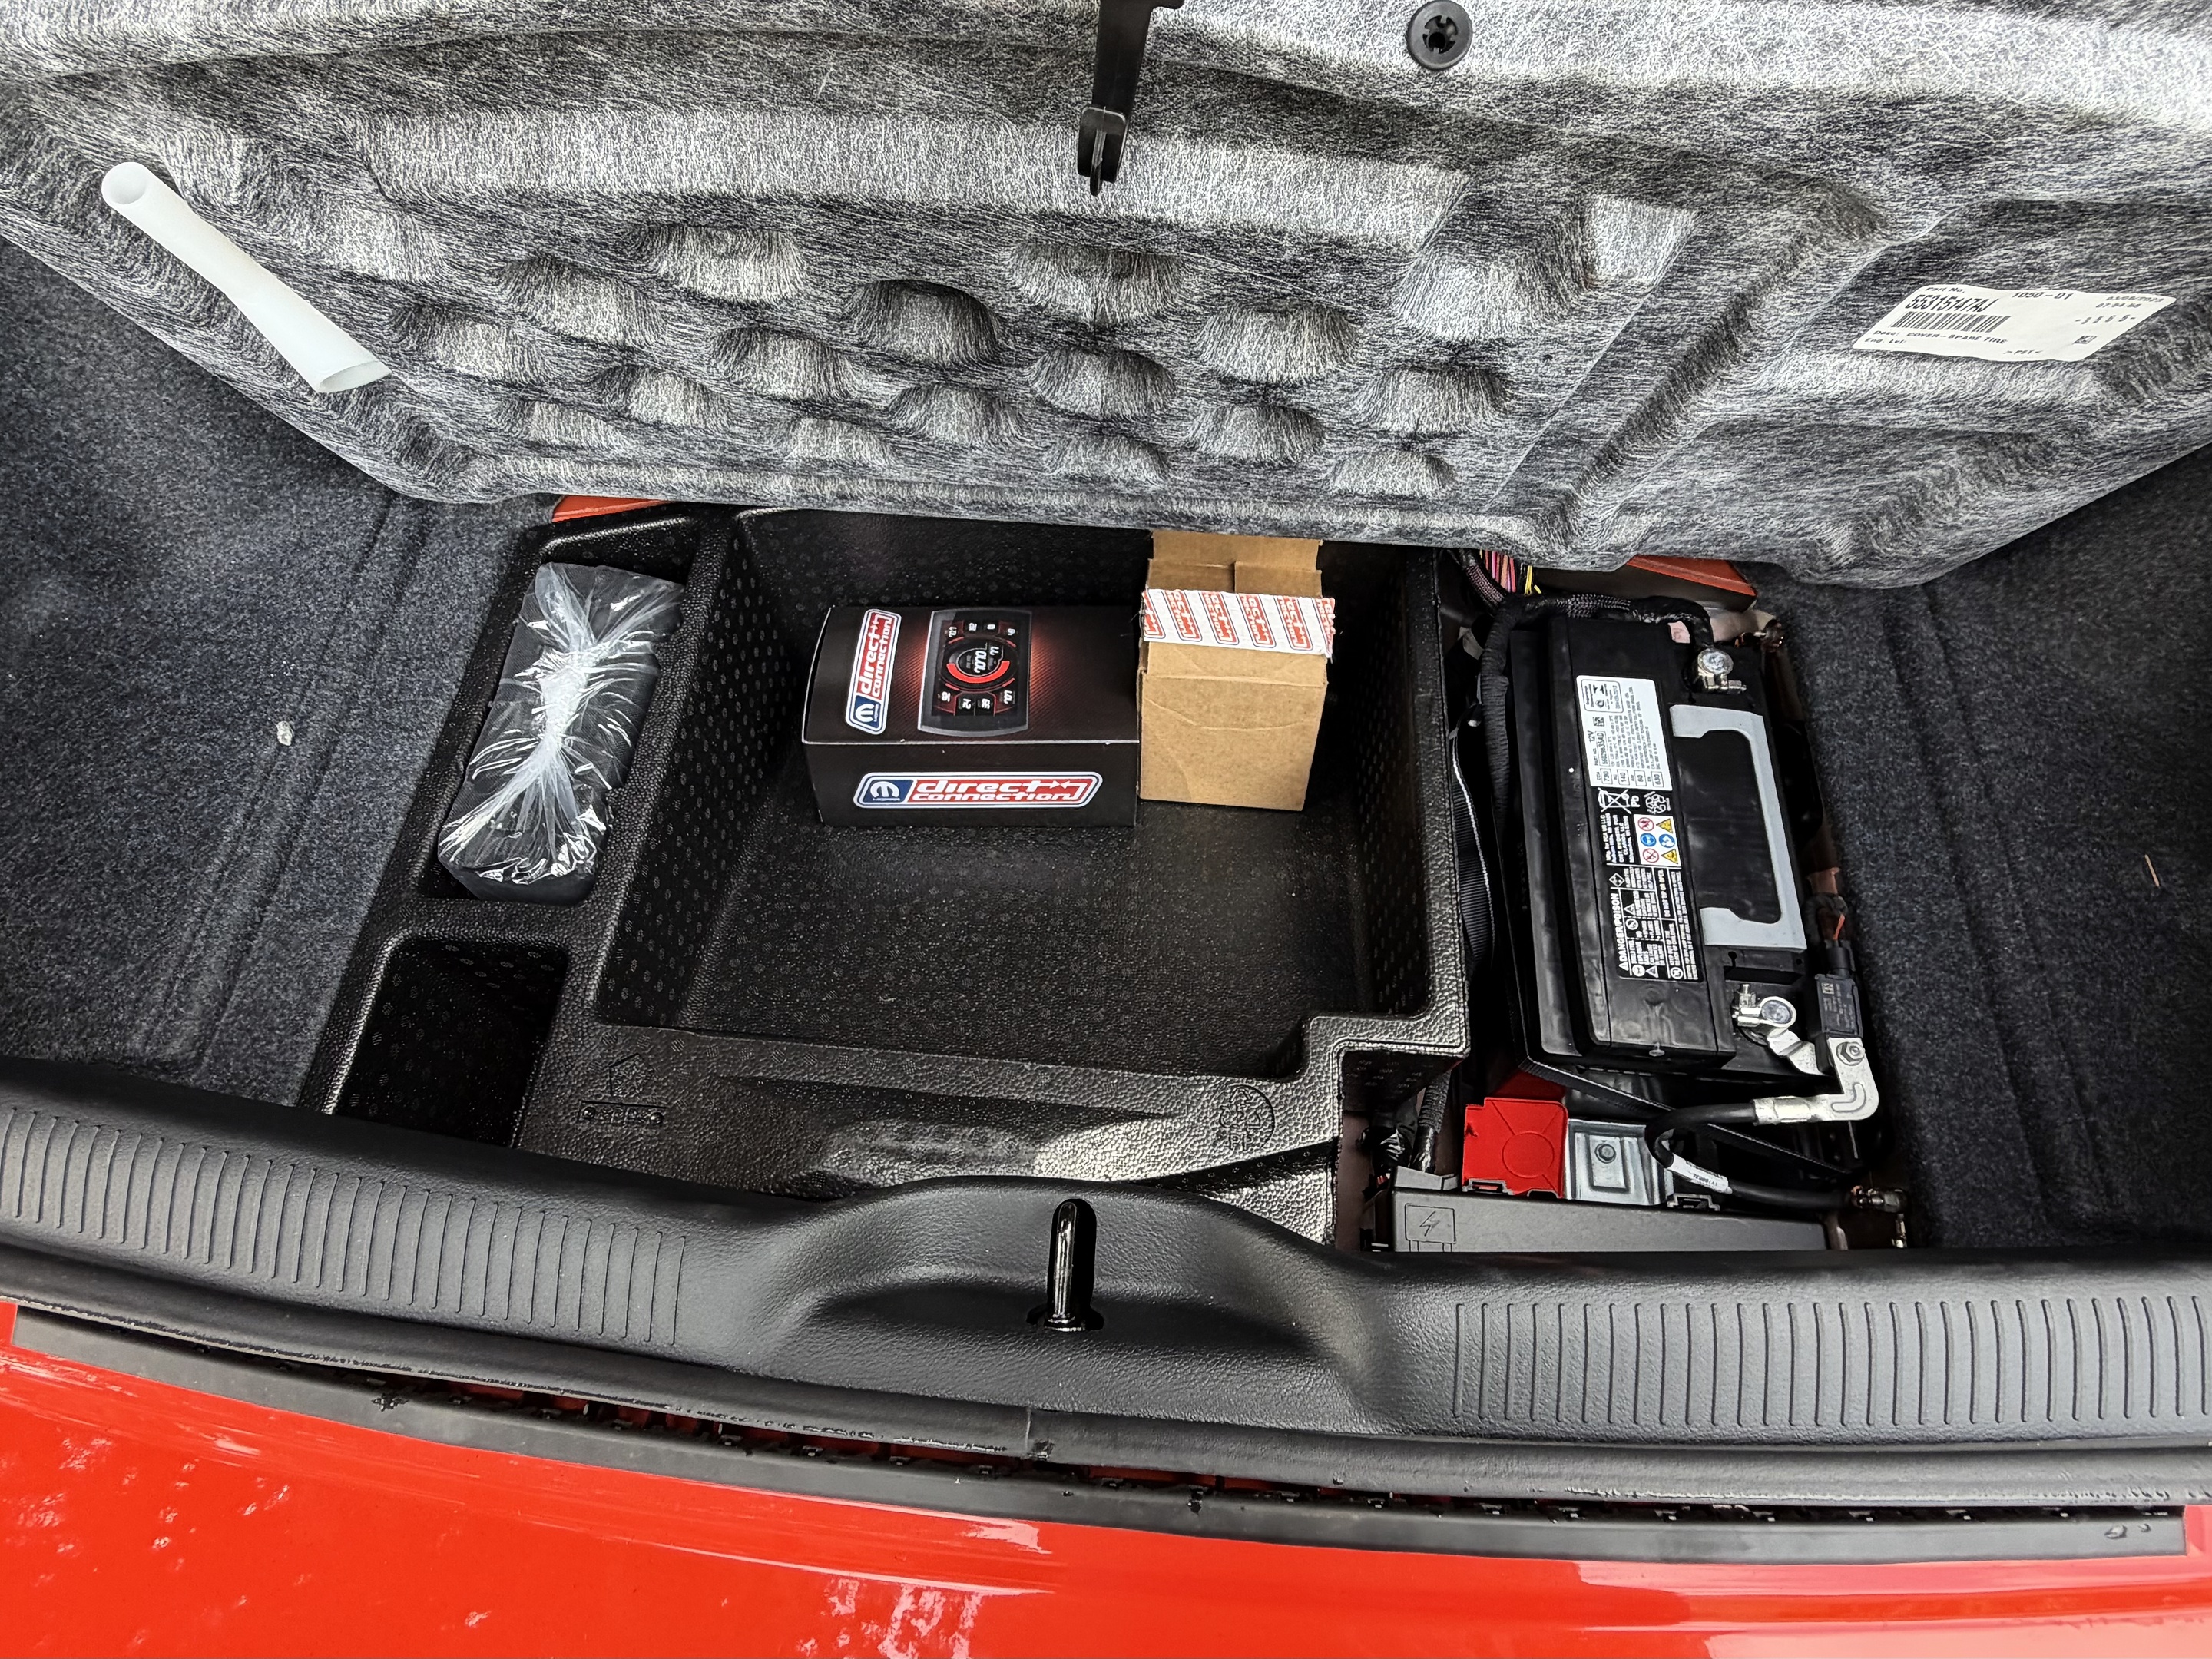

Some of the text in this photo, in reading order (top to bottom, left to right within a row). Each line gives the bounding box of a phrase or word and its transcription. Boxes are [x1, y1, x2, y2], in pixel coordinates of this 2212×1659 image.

[859, 630, 881, 694] direct
[872, 617, 893, 697] connection
[1587, 730, 1595, 742] 12V
[917, 780, 1045, 793] direct
[912, 792, 1080, 801] connection
[1629, 795, 1640, 807] Pb
[1611, 893, 1627, 961] DANGER/POISON
